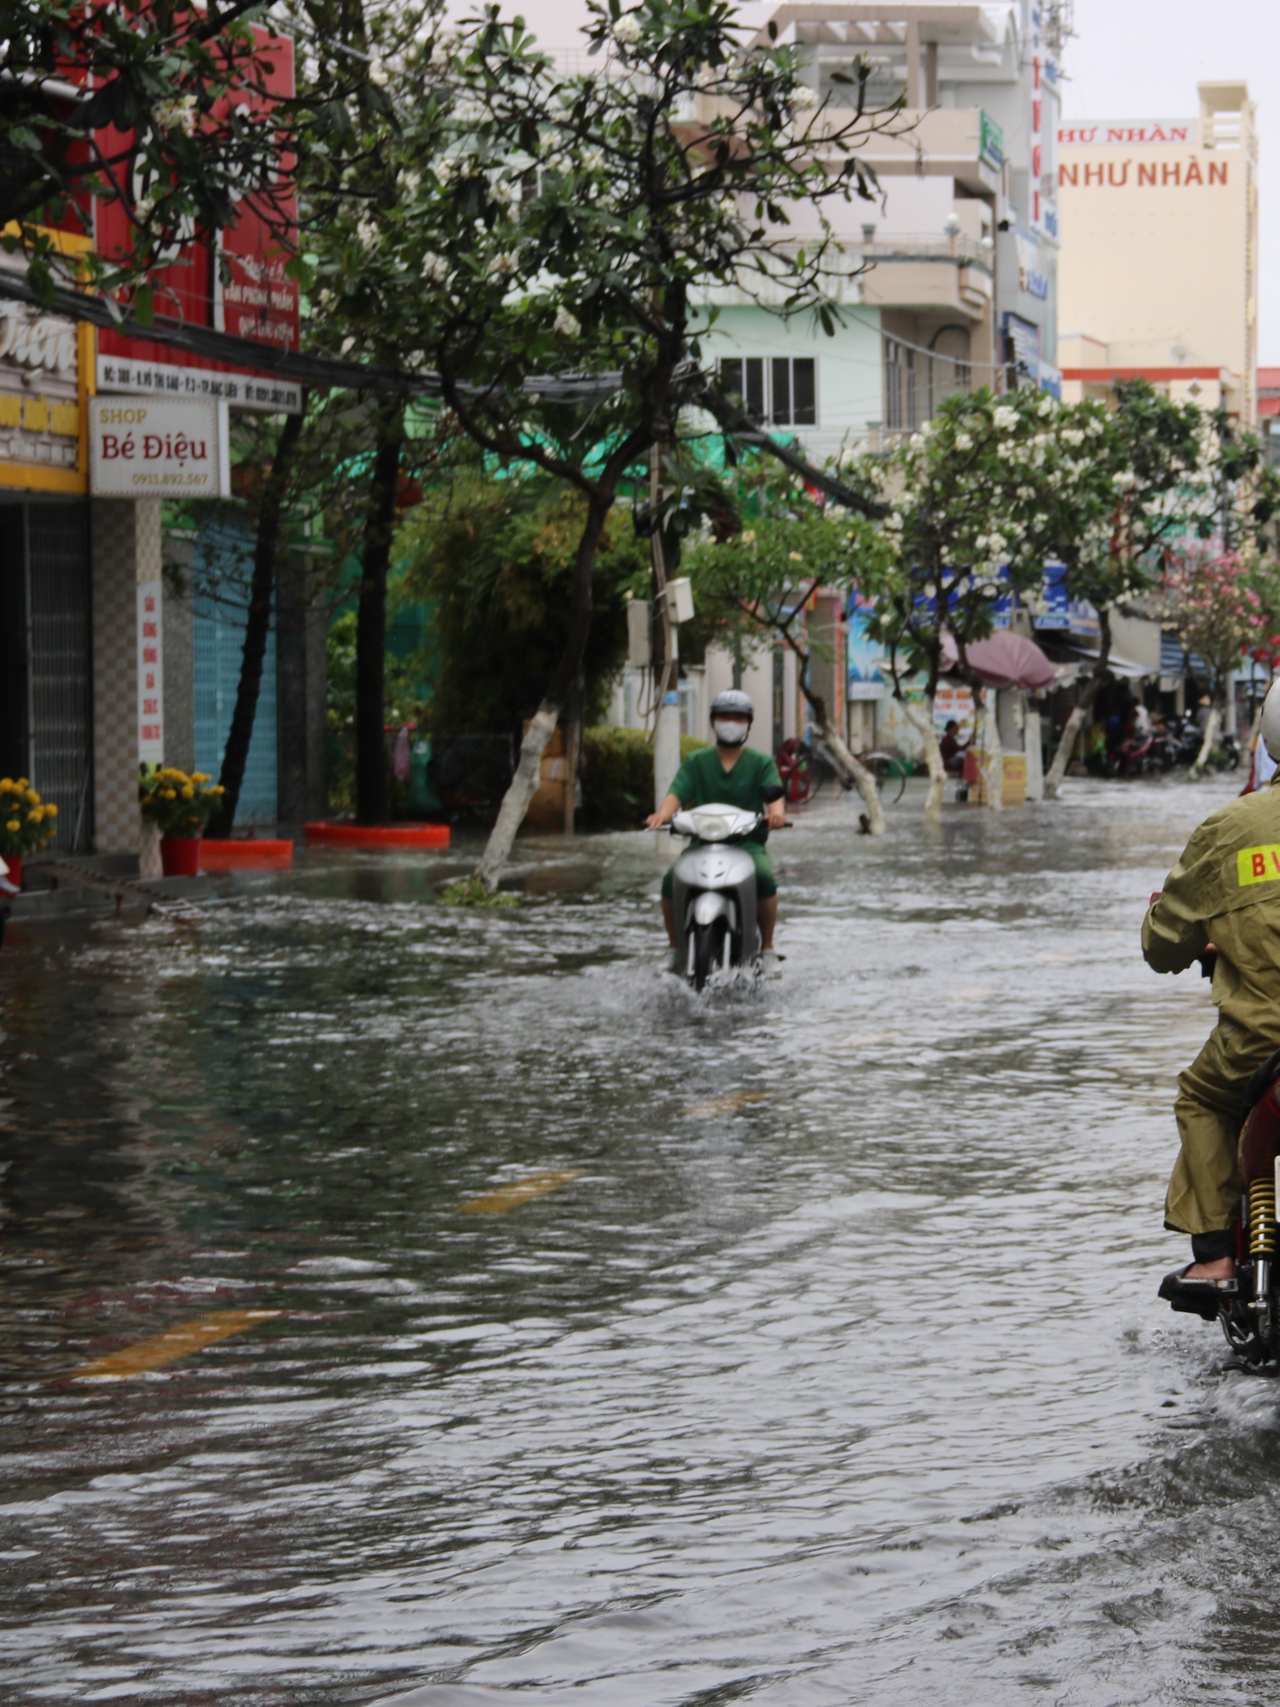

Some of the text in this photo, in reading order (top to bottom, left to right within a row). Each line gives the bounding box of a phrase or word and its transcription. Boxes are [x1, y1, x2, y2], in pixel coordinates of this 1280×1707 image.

[1106, 124, 1188, 142] NHÀN
[1058, 154, 1228, 187] NHƯ NHÀN
[100, 409, 147, 424] SHOP
[102, 431, 135, 459] Bé
[143, 431, 207, 468] Điệu
